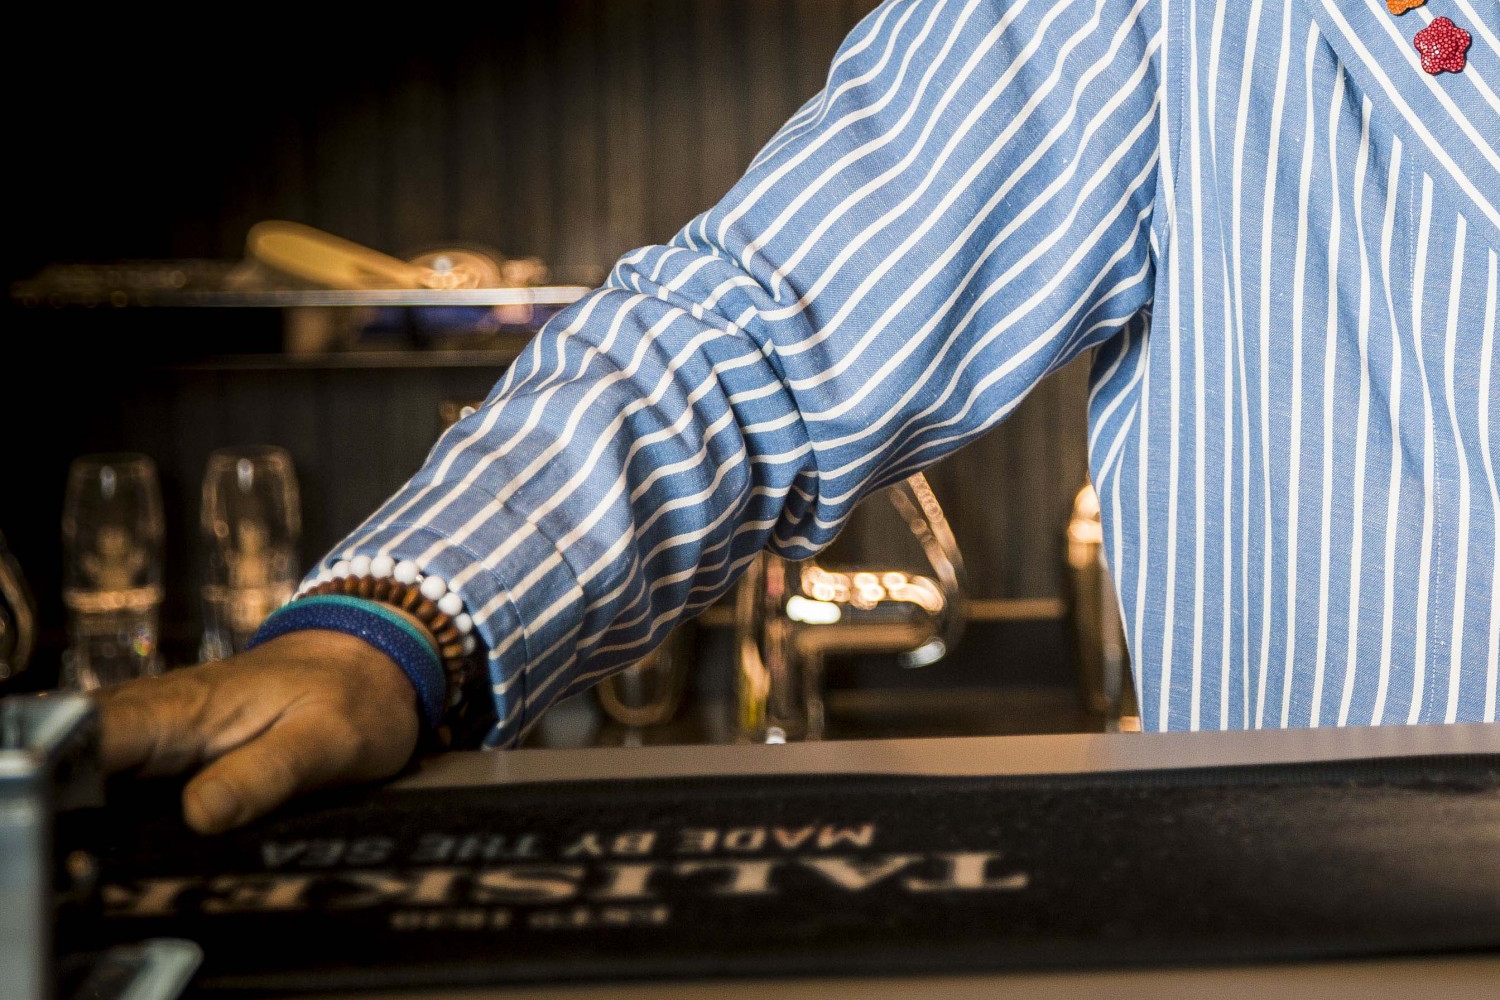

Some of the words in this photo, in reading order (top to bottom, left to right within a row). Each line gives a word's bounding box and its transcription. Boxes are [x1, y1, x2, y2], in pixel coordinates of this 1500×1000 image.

[261, 836, 395, 868] SEA
[409, 833, 538, 864] THE
[560, 831, 656, 858] BY
[675, 825, 876, 856] MADE
